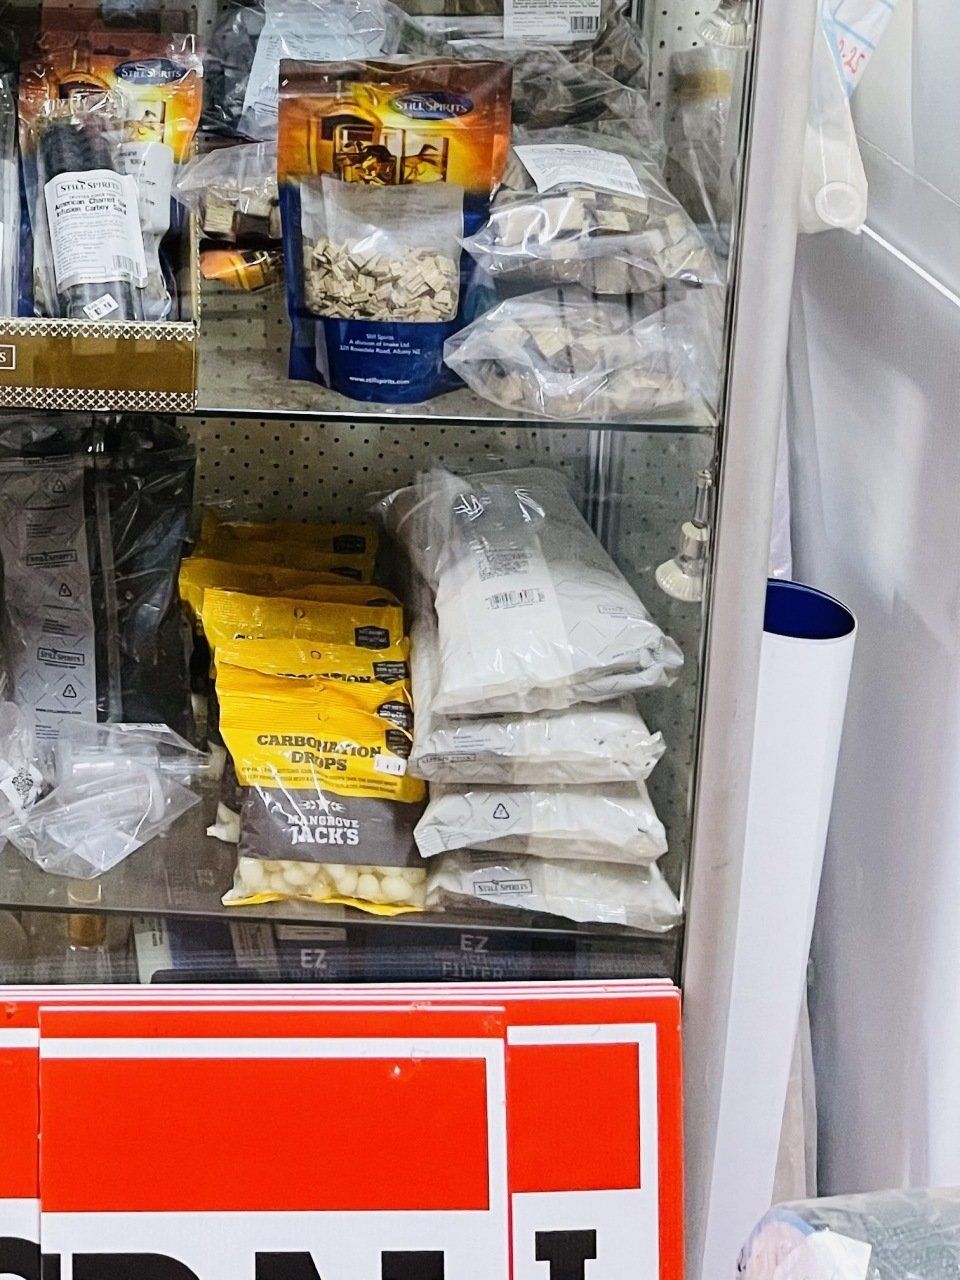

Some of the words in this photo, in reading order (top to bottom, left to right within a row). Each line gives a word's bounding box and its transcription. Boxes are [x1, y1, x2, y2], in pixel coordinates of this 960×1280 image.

[395, 100, 425, 111] STILL
[425, 101, 469, 113] SPIRITS
[61, 182, 86, 191] STILL
[87, 182, 119, 190] SPIRITS
[257, 735, 381, 758] CARBONATION
[291, 751, 348, 771] DROPS
[288, 815, 360, 828] MANGROVE
[290, 826, 360, 845] JACK'S
[460, 935, 489, 953] EZ
[300, 949, 327, 969] EZ
